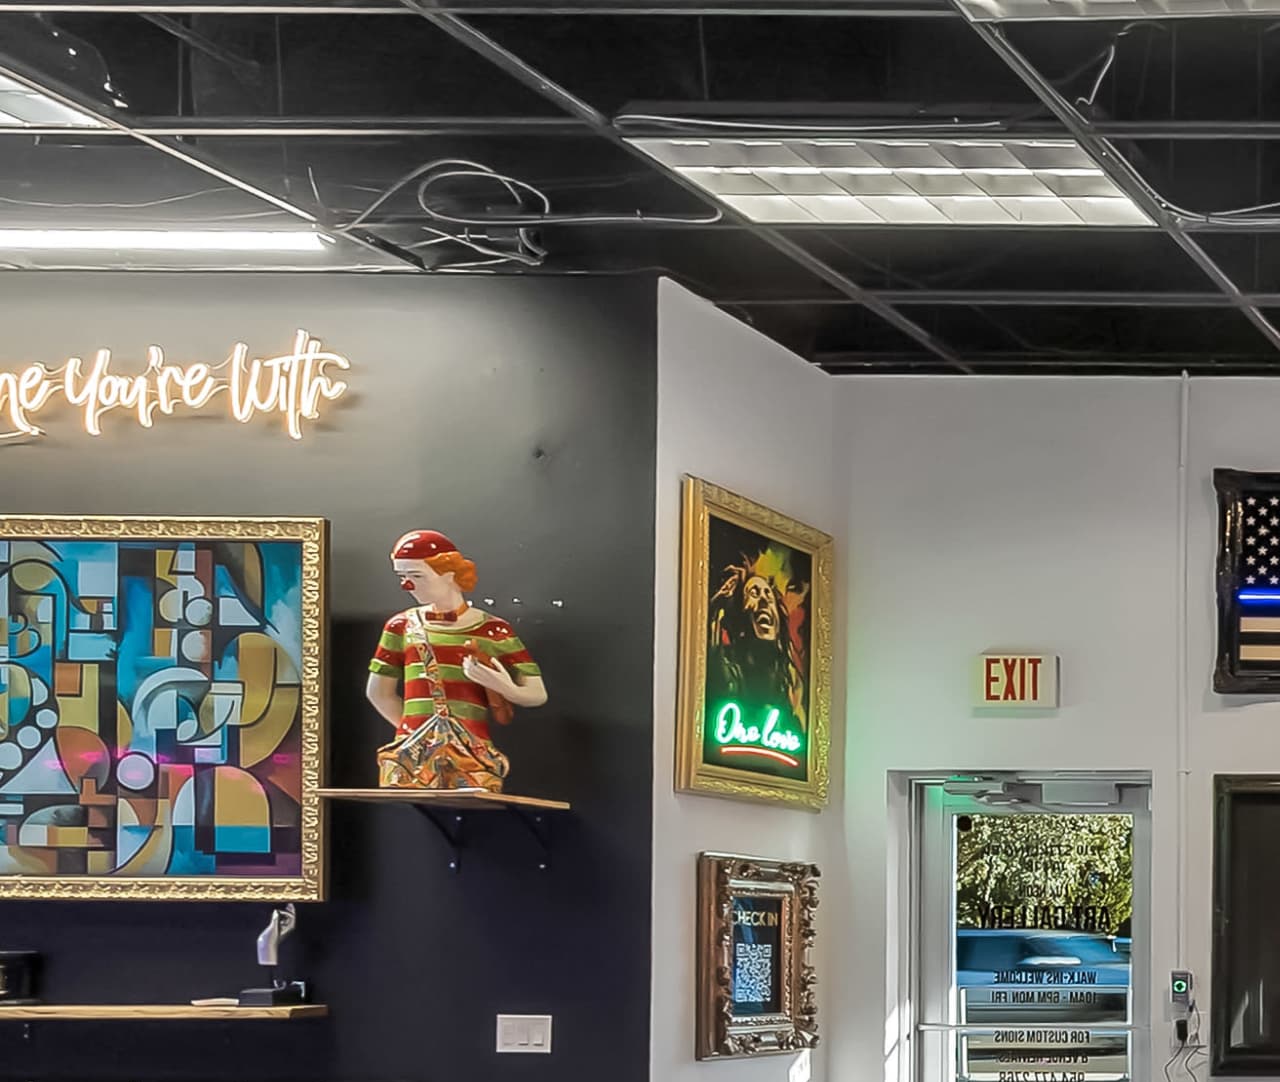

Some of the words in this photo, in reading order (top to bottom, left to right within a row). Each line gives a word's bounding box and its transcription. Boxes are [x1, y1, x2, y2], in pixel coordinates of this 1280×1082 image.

[63, 344, 218, 436] You're
[229, 328, 350, 440] With
[985, 657, 1042, 701] EXIT
[717, 702, 761, 744] One
[767, 911, 778, 926] IN
